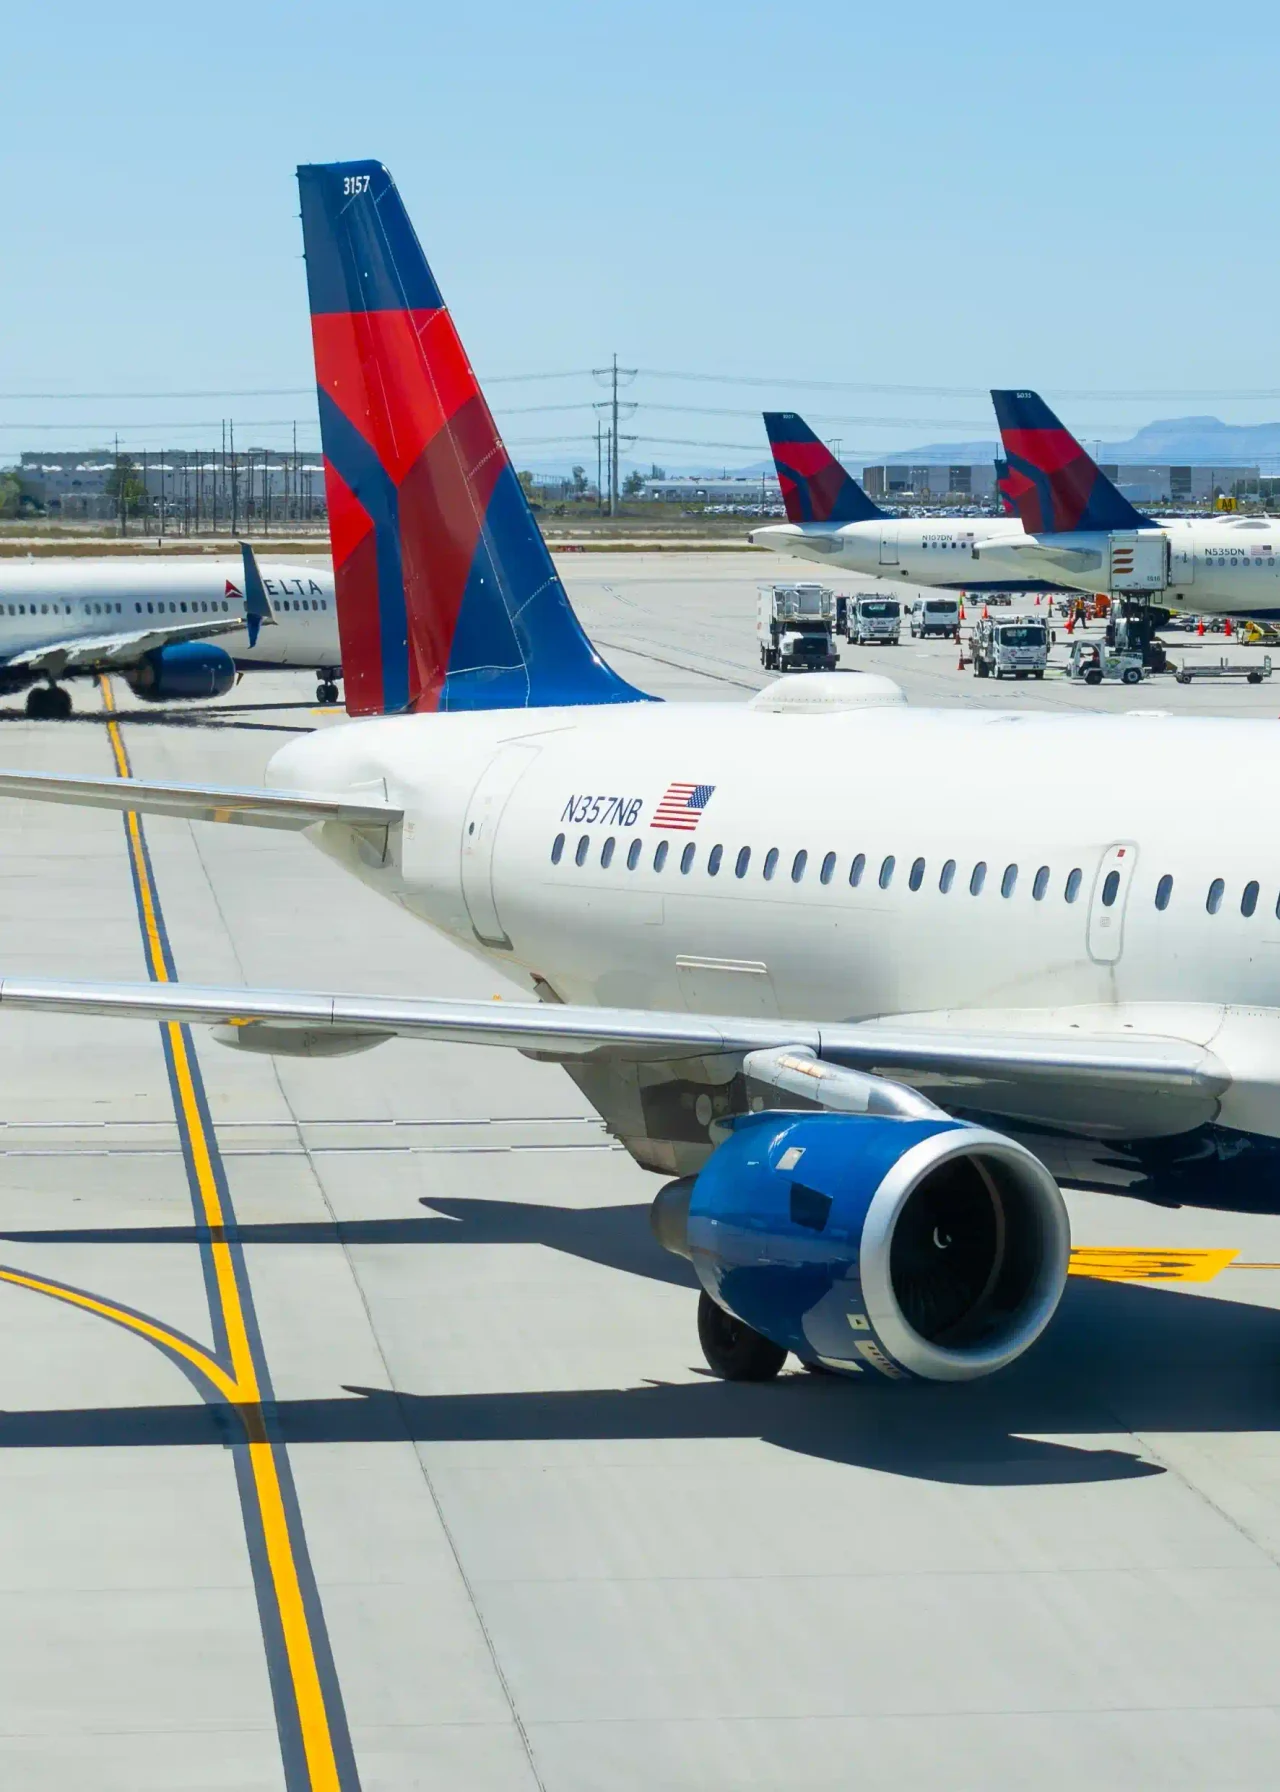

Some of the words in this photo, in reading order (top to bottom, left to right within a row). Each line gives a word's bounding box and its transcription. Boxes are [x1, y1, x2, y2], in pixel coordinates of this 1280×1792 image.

[343, 176, 370, 195] 3157
[1221, 499, 1233, 510] A4
[1205, 548, 1245, 556] N535DN
[262, 579, 323, 596] ELTA
[560, 795, 643, 827] N357NB
